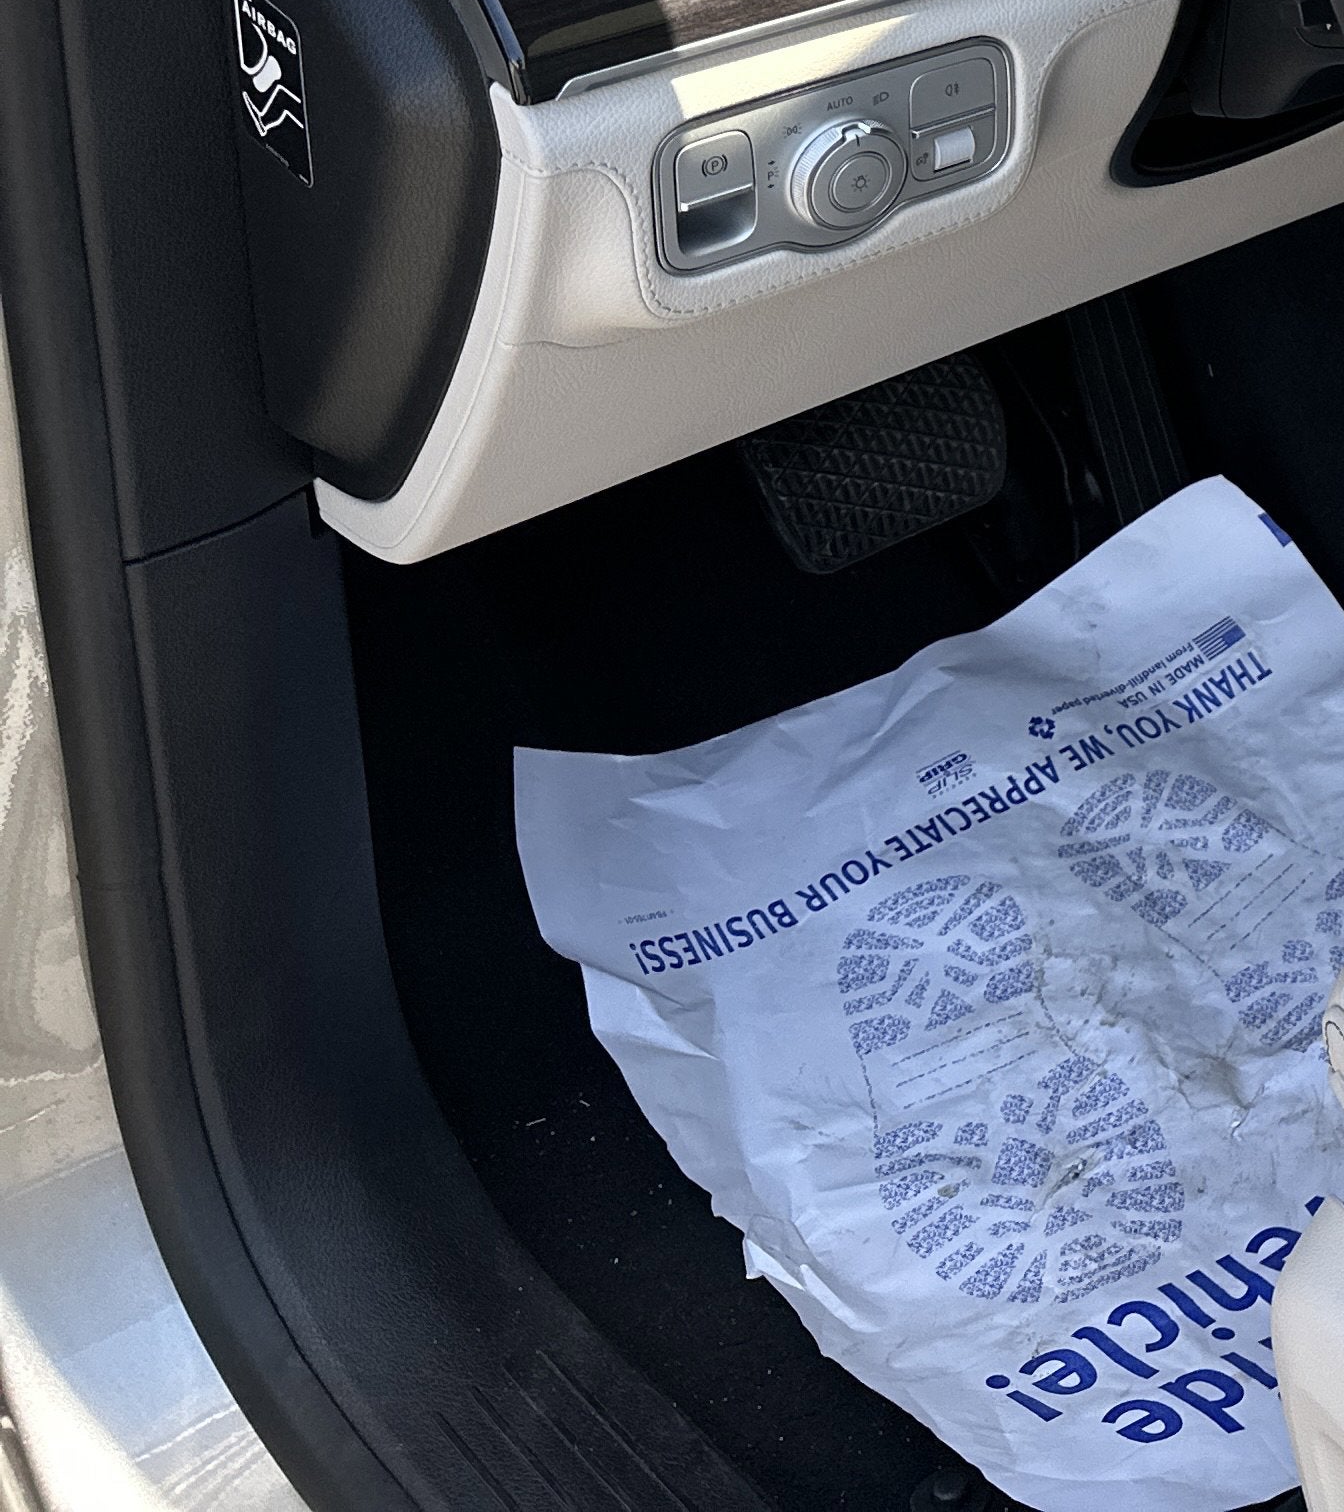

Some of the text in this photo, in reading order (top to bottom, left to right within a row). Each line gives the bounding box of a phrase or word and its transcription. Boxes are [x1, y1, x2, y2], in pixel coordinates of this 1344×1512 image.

[242, 0, 297, 55] AIRBAG
[826, 95, 854, 111] AUTO
[1051, 641, 1195, 715] From landfill-diverted paper
[1117, 654, 1206, 709] MADE IN USA
[919, 753, 968, 783] GRIP
[927, 763, 973, 795] SLIP
[628, 650, 1273, 975] THANK YOU, WE APPRECIATE YOUR BUSINESS!
[1101, 1336, 1281, 1444] ide
